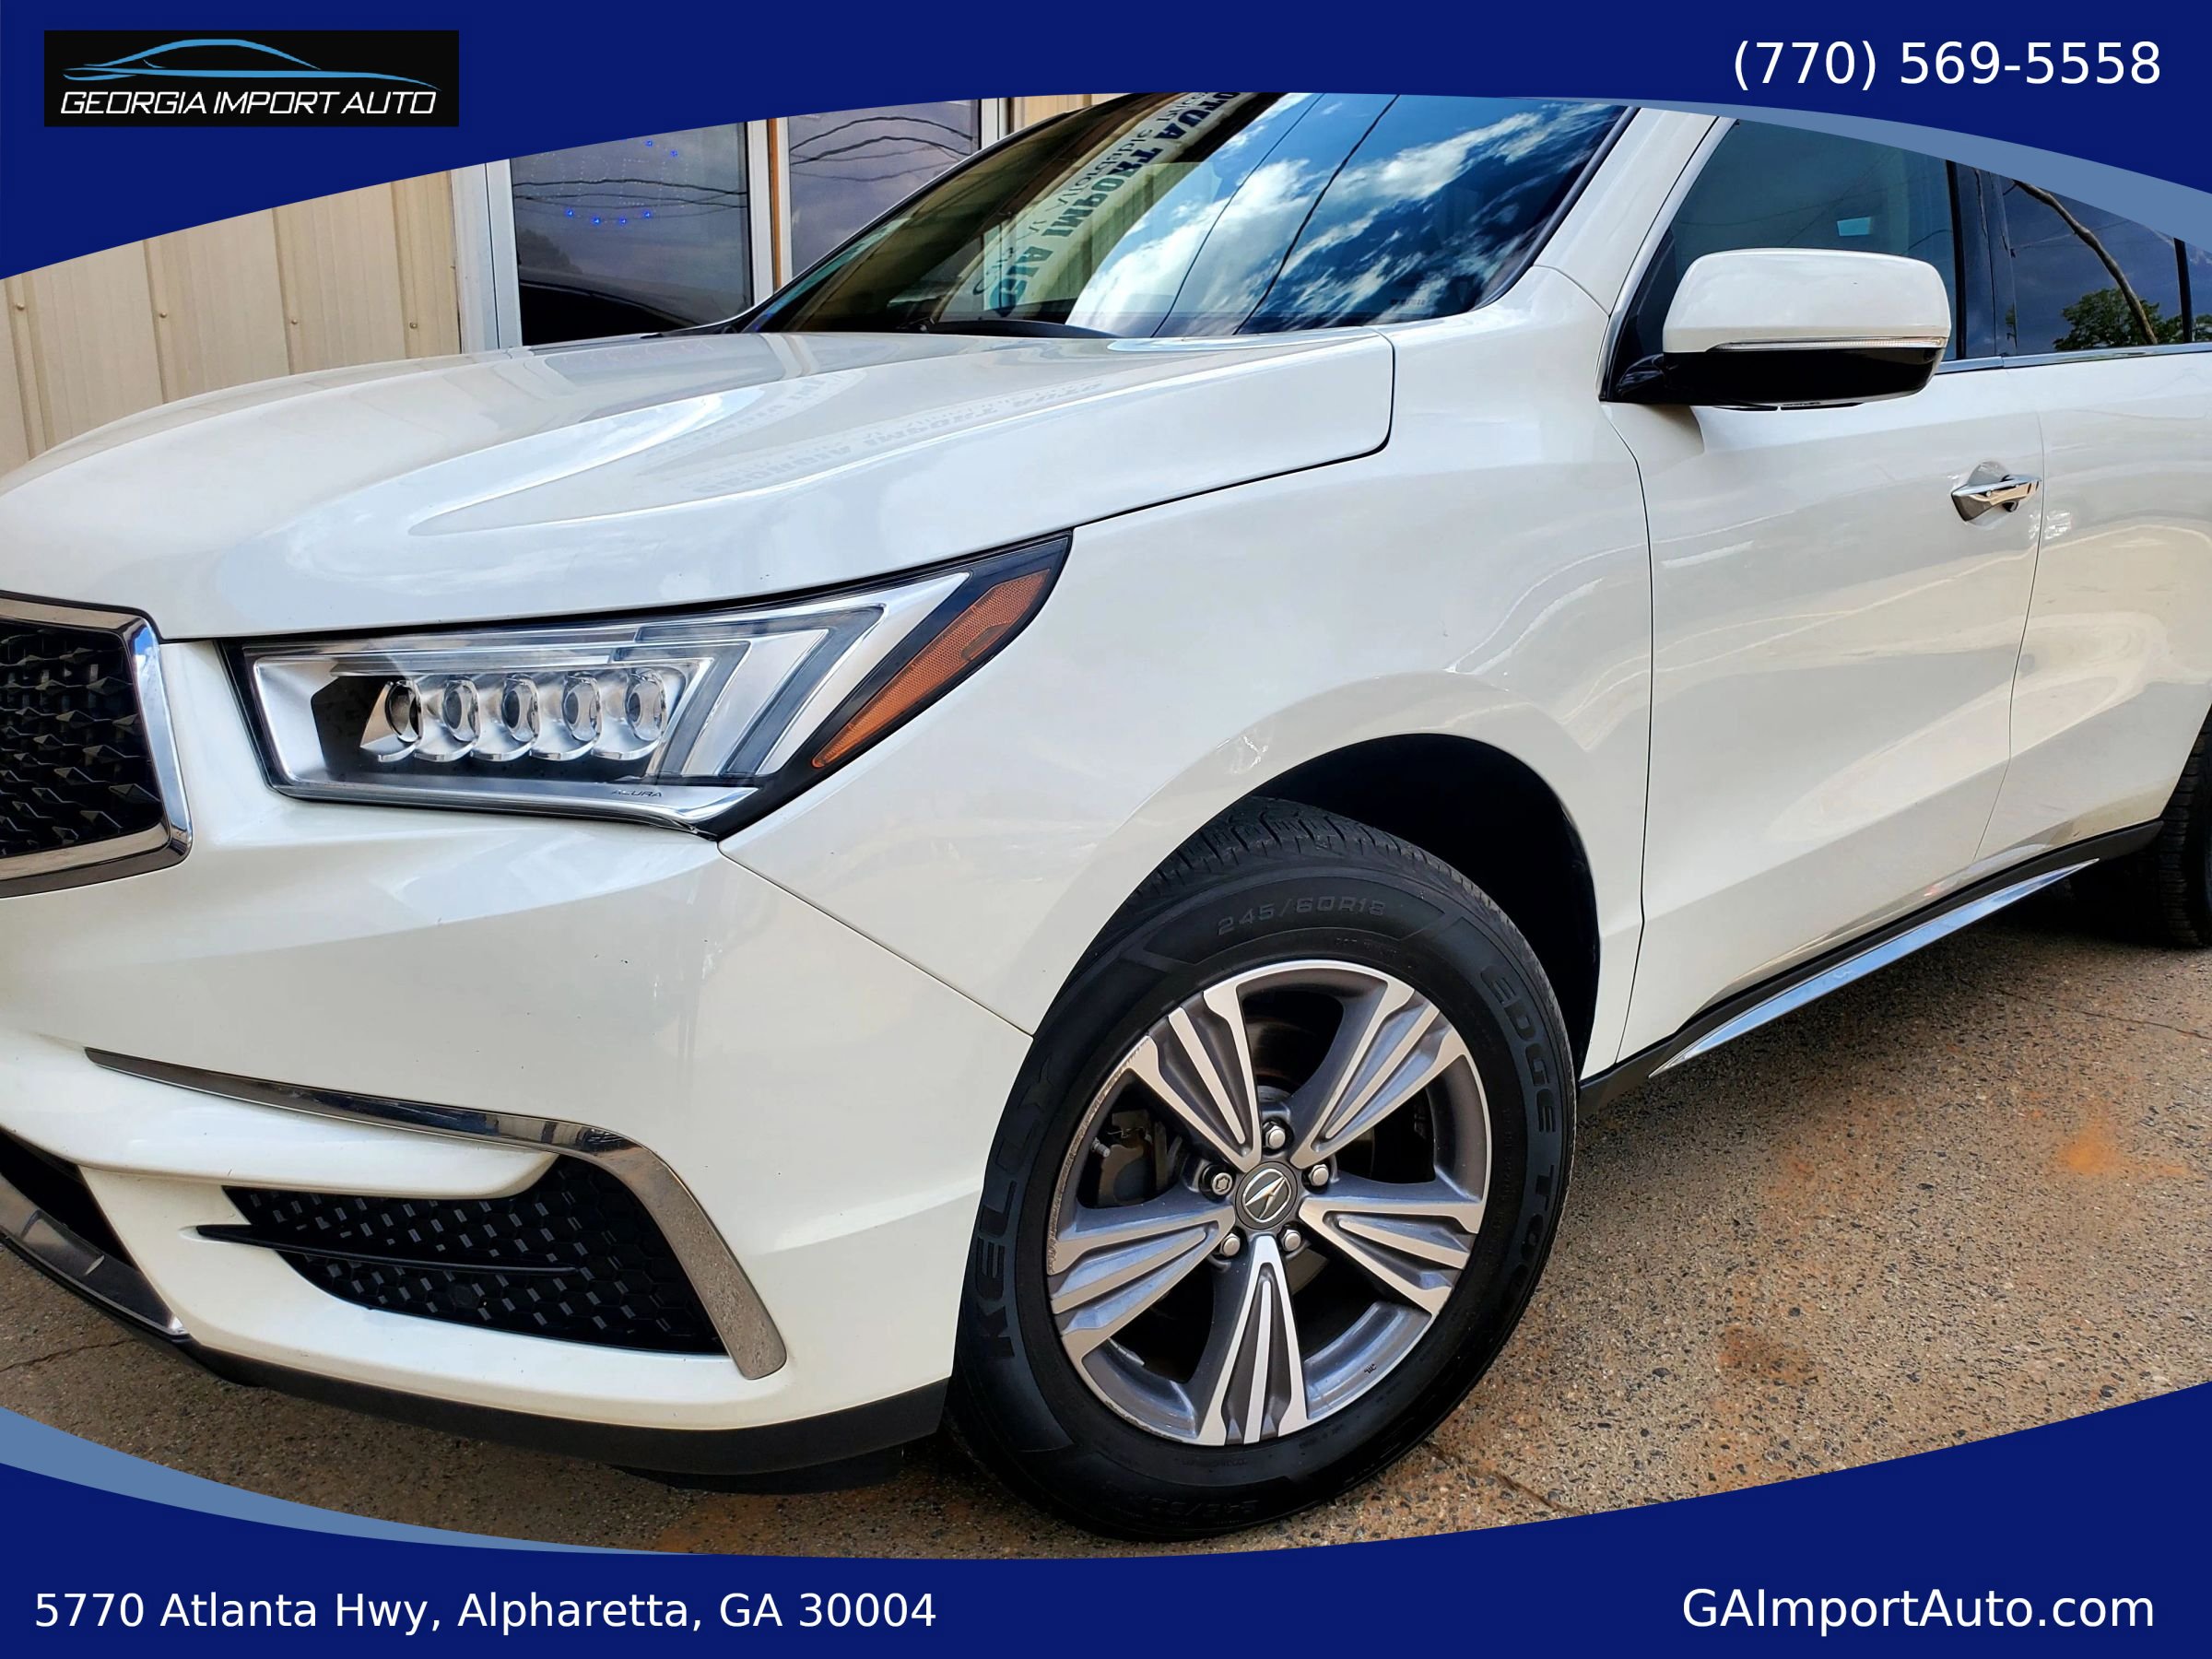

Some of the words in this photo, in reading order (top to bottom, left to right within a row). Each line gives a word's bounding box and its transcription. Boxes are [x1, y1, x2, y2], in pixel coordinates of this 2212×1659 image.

[1218, 896, 1386, 936] 245/60R18
[1480, 964, 1557, 1134] EDGE
[975, 1056, 1053, 1358] KELLY
